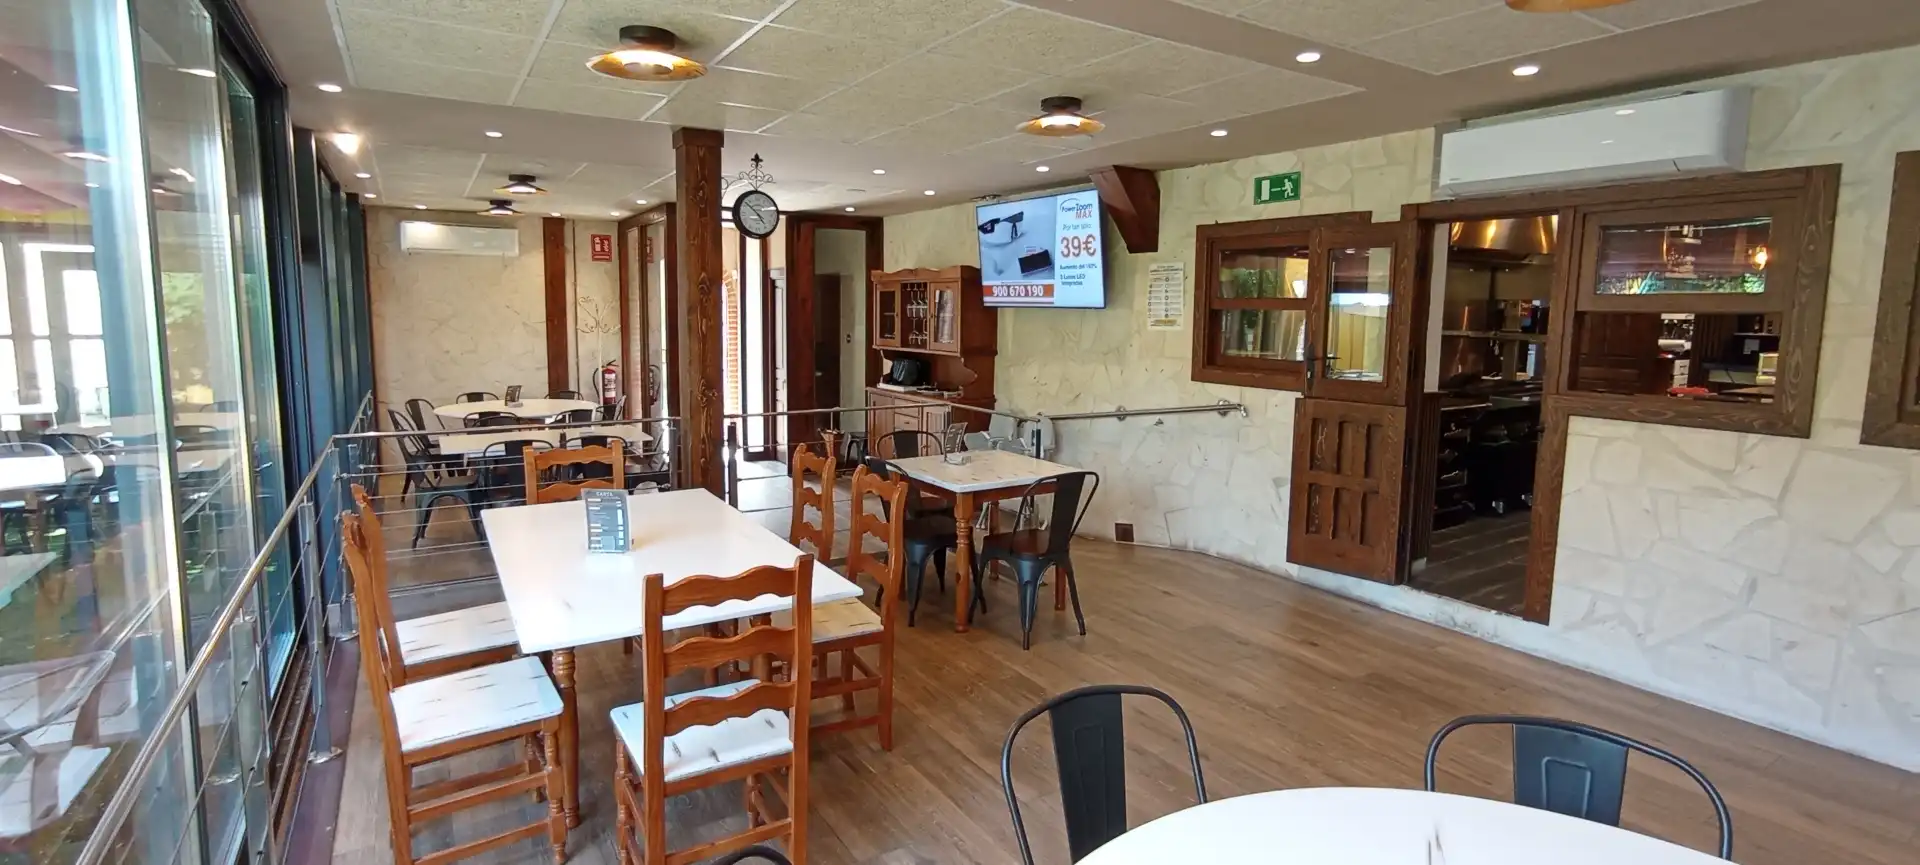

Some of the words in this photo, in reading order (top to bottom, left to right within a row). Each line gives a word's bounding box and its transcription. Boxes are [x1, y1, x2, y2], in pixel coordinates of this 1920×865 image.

[1075, 211, 1093, 219] MAX
[1061, 234, 1097, 258] 39€
[992, 285, 1008, 297] 900
[1010, 285, 1026, 297] 670
[1027, 284, 1044, 297] 190
